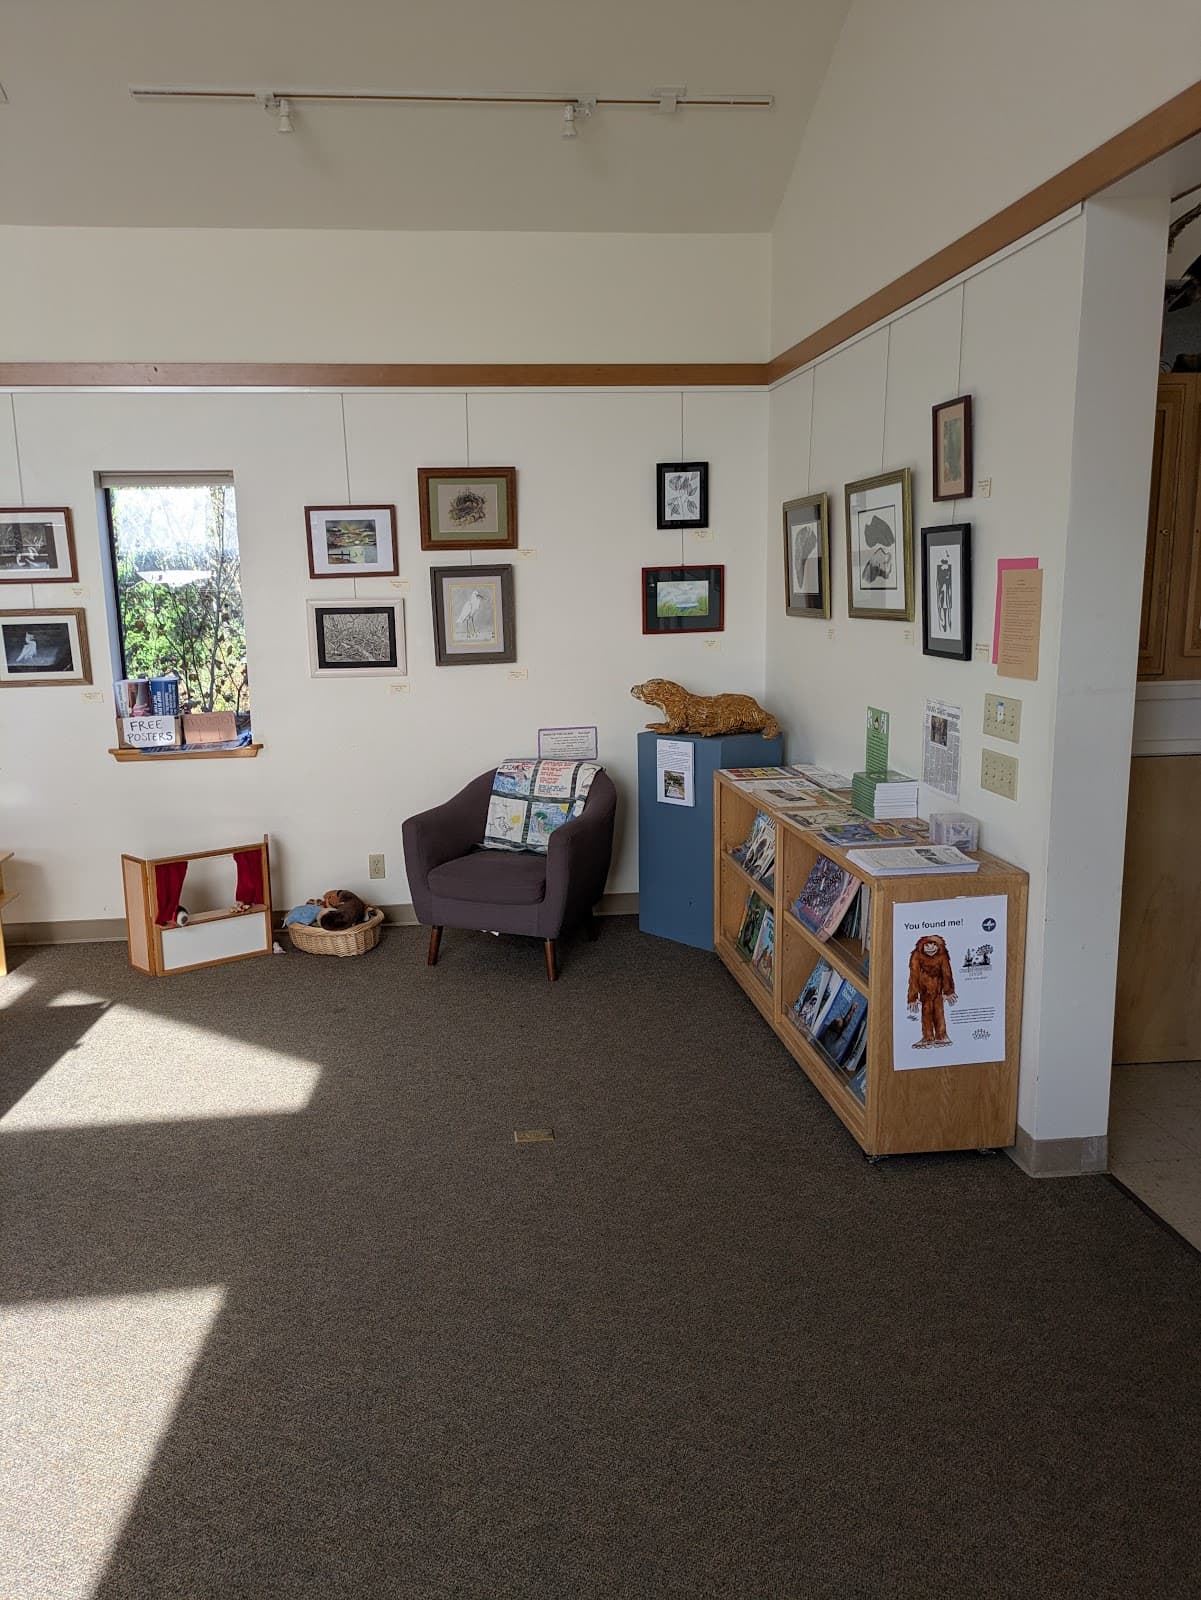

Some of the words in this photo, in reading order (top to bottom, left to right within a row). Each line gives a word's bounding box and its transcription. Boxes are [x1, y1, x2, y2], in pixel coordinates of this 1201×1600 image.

[130, 720, 163, 731] FREE
[127, 731, 173, 743] POSTERS
[903, 922, 920, 930] You
[922, 919, 946, 929] found
[948, 917, 964, 928] me!
